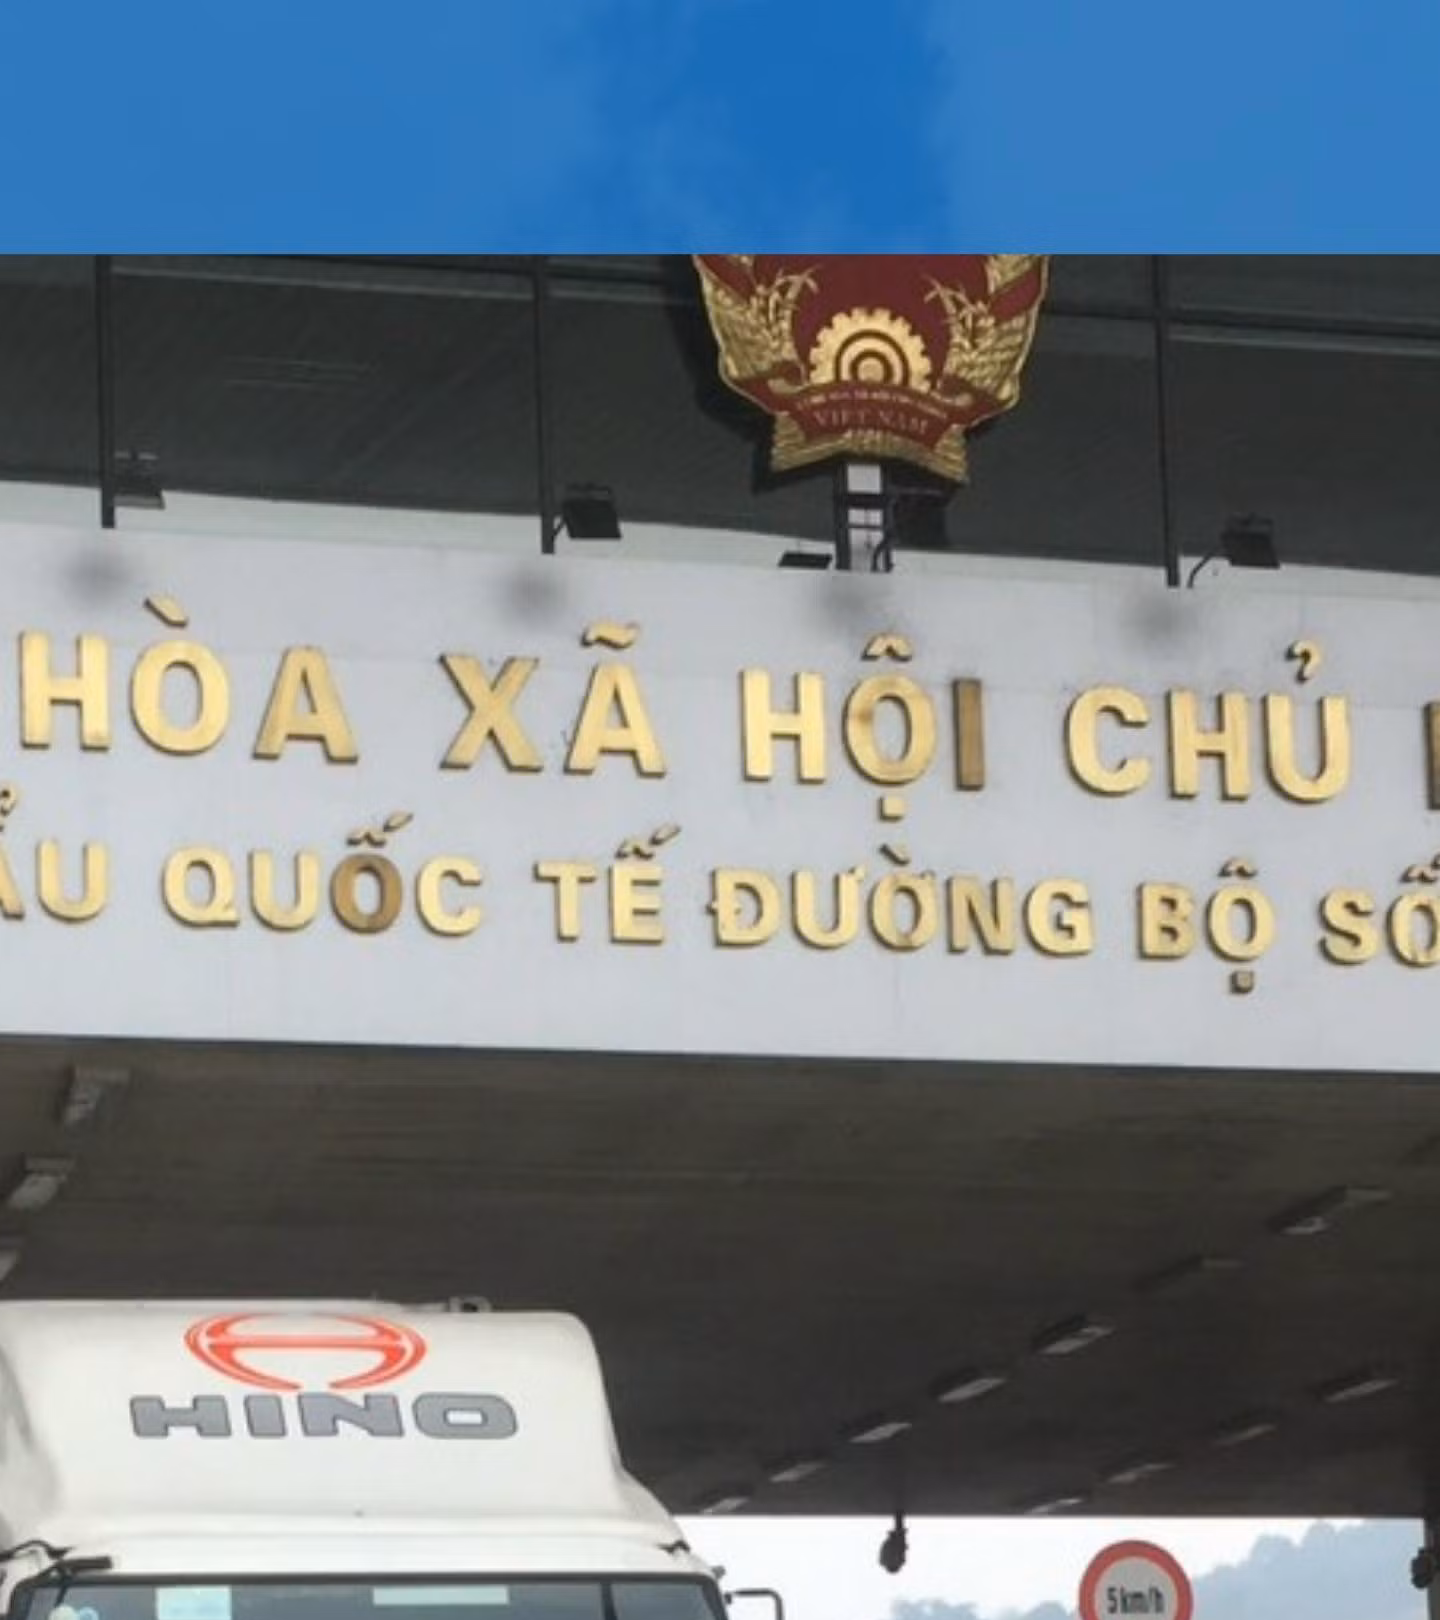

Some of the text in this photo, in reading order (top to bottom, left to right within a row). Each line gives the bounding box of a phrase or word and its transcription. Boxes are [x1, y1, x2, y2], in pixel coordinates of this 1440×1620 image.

[17, 596, 358, 763] HÒA
[438, 621, 668, 780] XÃ
[739, 633, 986, 821] HỘI
[1065, 639, 1353, 803] CHỦ
[159, 812, 485, 937] QUỐC
[534, 824, 680, 946] TẾ
[705, 842, 1096, 958] ĐƯỜNG
[1136, 856, 1277, 994] BỘ
[128, 1391, 519, 1439] HINO
[1106, 1586, 1118, 1614] 5
